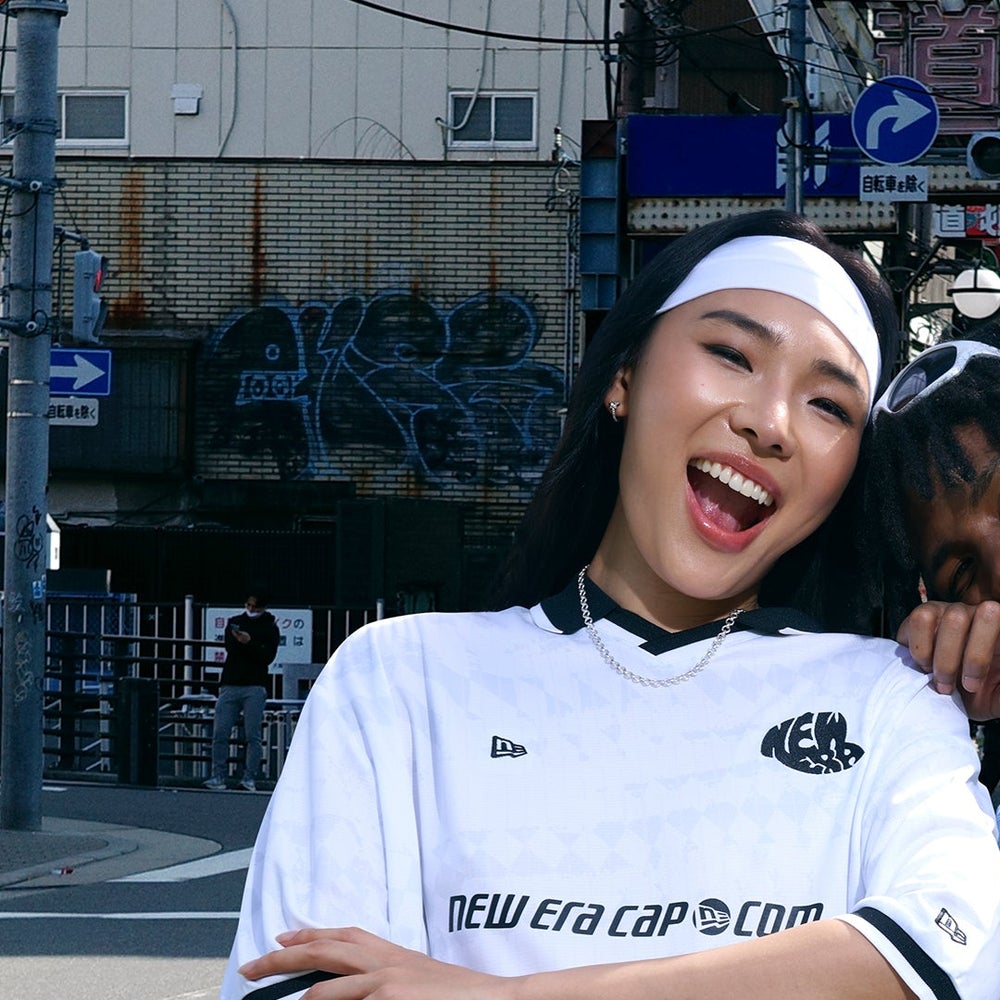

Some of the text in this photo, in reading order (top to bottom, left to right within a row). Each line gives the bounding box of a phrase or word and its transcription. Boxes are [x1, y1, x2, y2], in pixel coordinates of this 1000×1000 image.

[863, 174, 925, 193] 自転車を除く
